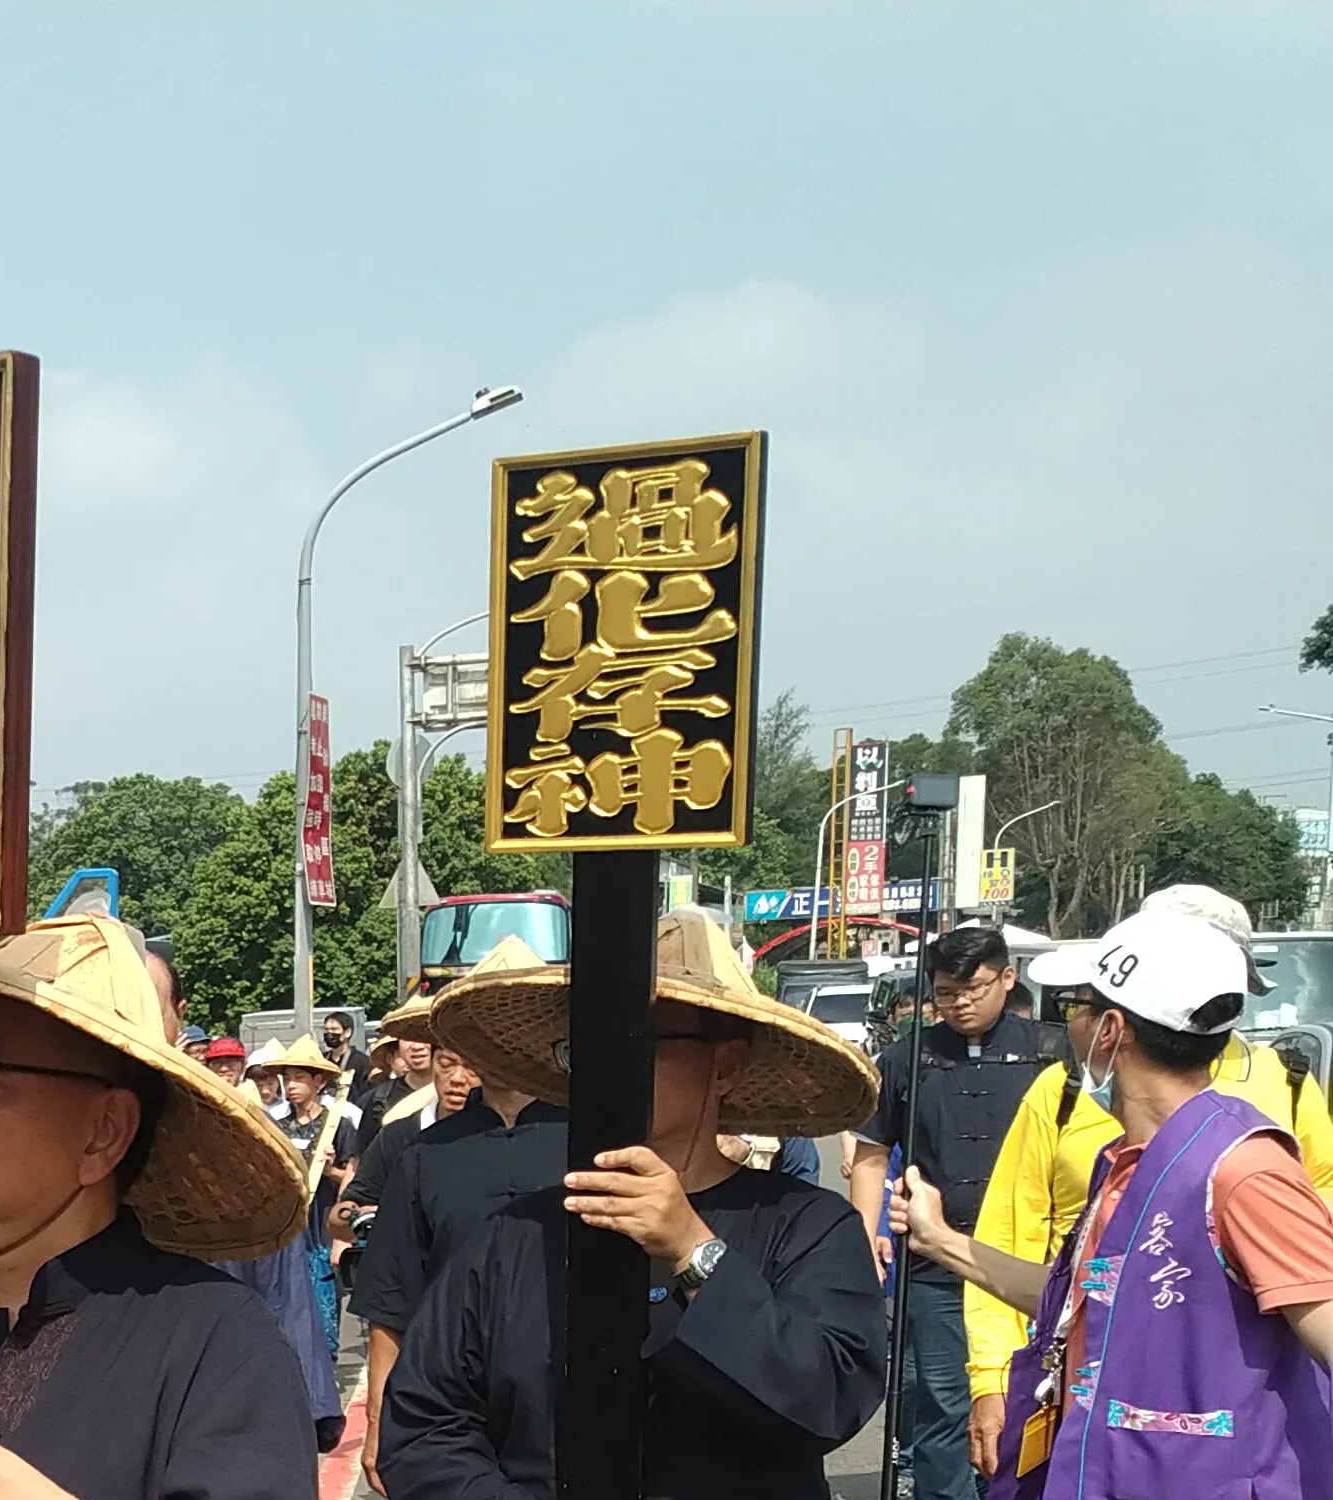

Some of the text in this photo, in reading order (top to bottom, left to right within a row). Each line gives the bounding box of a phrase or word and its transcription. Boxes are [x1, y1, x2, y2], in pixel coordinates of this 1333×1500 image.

[503, 458, 738, 837] 過化存神
[854, 746, 883, 811] 以利亞
[986, 851, 1009, 869] H
[791, 889, 841, 915] 正一
[983, 887, 1009, 900] 100
[1097, 944, 1139, 988] 49
[1139, 1210, 1192, 1310] 客家
